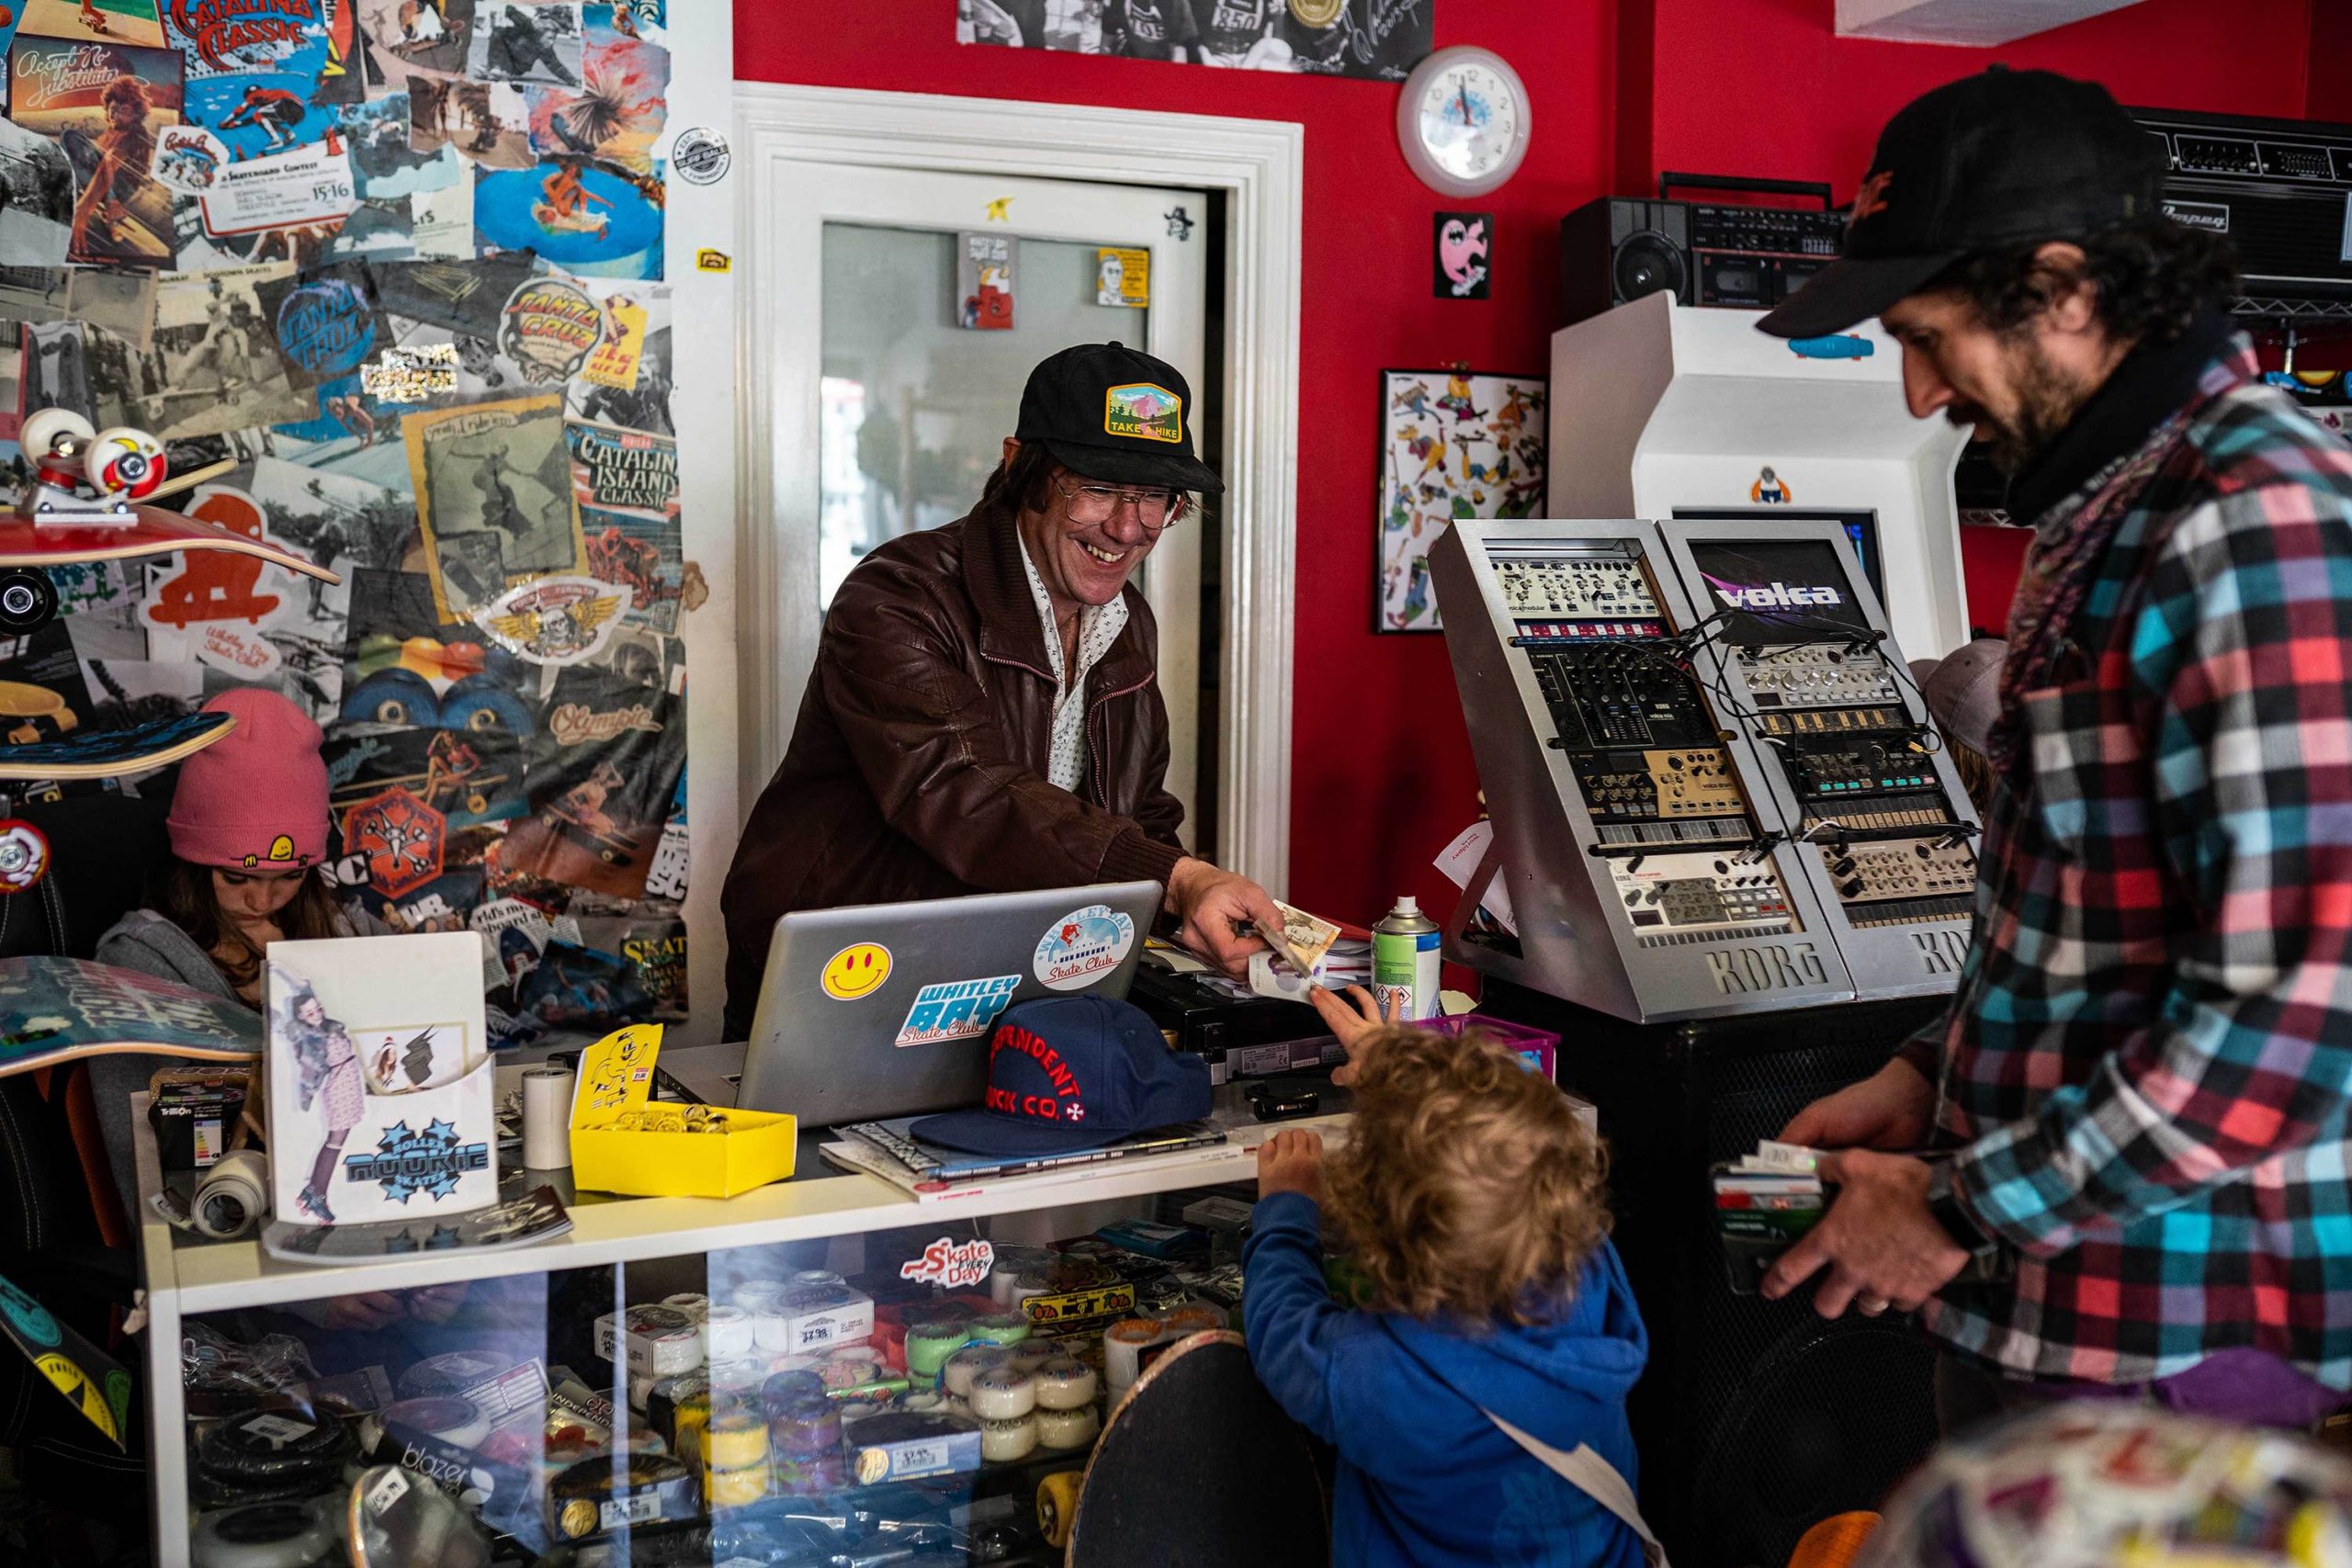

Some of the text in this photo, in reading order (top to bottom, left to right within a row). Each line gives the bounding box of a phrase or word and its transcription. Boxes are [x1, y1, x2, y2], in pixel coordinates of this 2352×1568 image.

[198, 19, 306, 71] CLASSIC
[17, 46, 111, 80] Accept No
[284, 162, 318, 174] CONTEST
[504, 292, 602, 328] SANTA
[520, 315, 597, 349] CRUZ
[1111, 421, 1178, 439] TAKE A HIKE
[596, 465, 677, 496] ISLAND
[600, 488, 667, 512] CLASSIC
[1715, 581, 1840, 610] volca
[553, 705, 662, 743] Olympic
[1049, 953, 1114, 981] Skate Club
[1910, 928, 1973, 975] KO
[1705, 942, 1828, 995] KORG
[919, 976, 1019, 1003] WHITLEY
[905, 993, 1012, 1032] BAY
[902, 1021, 980, 1042] Skate Club
[1022, 1094, 1061, 1121] CO.
[392, 1137, 447, 1156] ROLLER
[343, 1142, 490, 1183] ROOKIE
[394, 1170, 447, 1187] SKATES
[926, 1243, 989, 1274] Skate
[948, 1267, 982, 1283] Day
[401, 1441, 470, 1483] blazer
